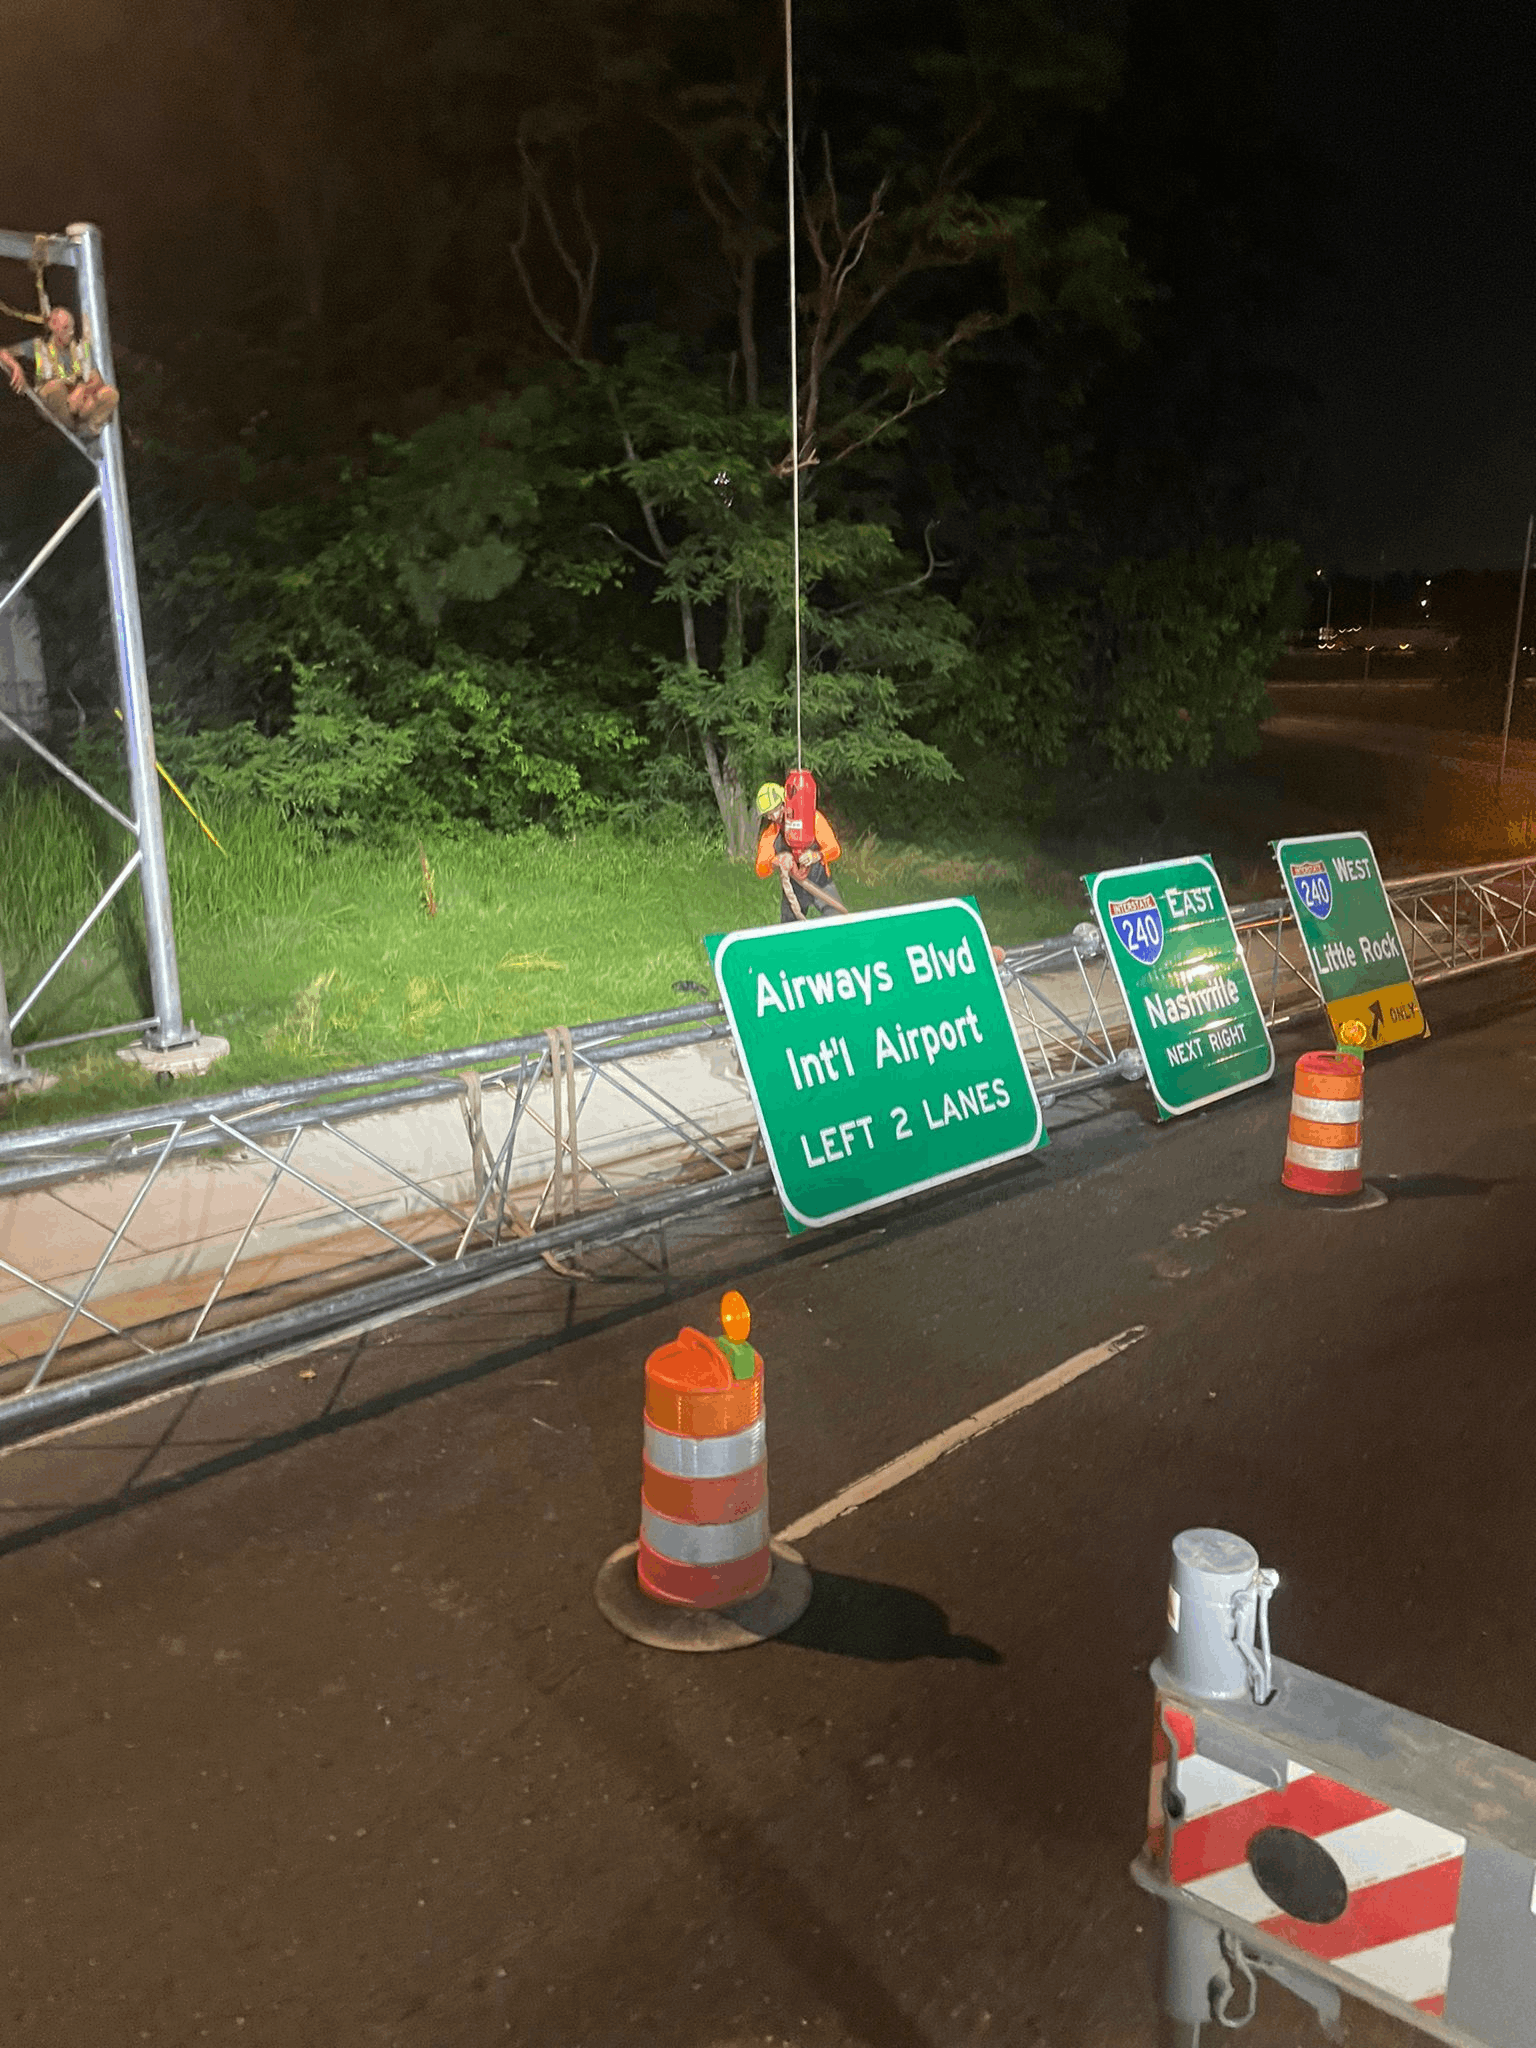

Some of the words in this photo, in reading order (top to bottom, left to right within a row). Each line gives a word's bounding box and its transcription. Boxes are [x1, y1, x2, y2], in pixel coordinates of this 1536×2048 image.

[1332, 856, 1372, 883] WEST
[1165, 886, 1215, 918] EAST
[1301, 877, 1330, 907] 240
[1122, 914, 1160, 951] 240
[1312, 940, 1357, 975] Little
[1358, 931, 1400, 965] Rock
[757, 960, 894, 1018] Airways
[905, 935, 976, 985] Blvd
[1144, 975, 1240, 1029] Nashville
[1389, 1001, 1418, 1024] ONLY
[785, 1036, 855, 1091] Int'l
[876, 1004, 983, 1070] Airport
[1166, 1037, 1204, 1068] NEXT
[1209, 1023, 1248, 1053] RIGHT
[800, 1115, 875, 1169] LEFT
[890, 1106, 913, 1140] 2
[922, 1077, 1011, 1131] LANES
